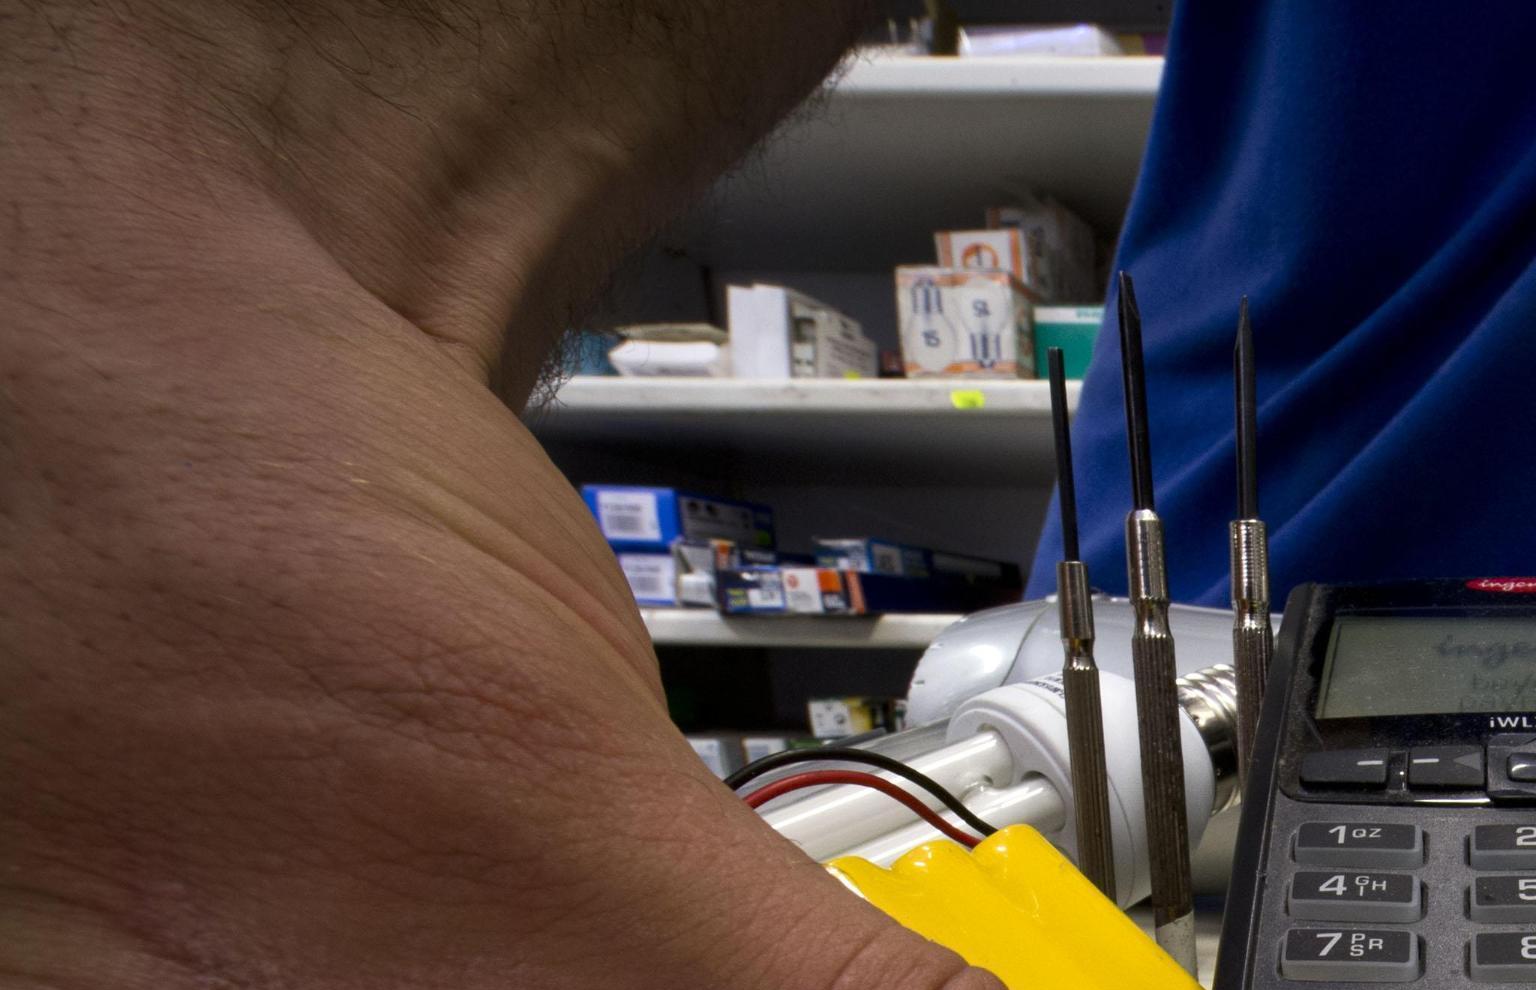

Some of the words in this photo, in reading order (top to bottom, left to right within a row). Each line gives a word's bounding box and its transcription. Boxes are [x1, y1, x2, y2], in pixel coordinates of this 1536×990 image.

[1328, 825, 1347, 844] 1
[1318, 875, 1347, 896] 4
[1316, 932, 1343, 956] 7
